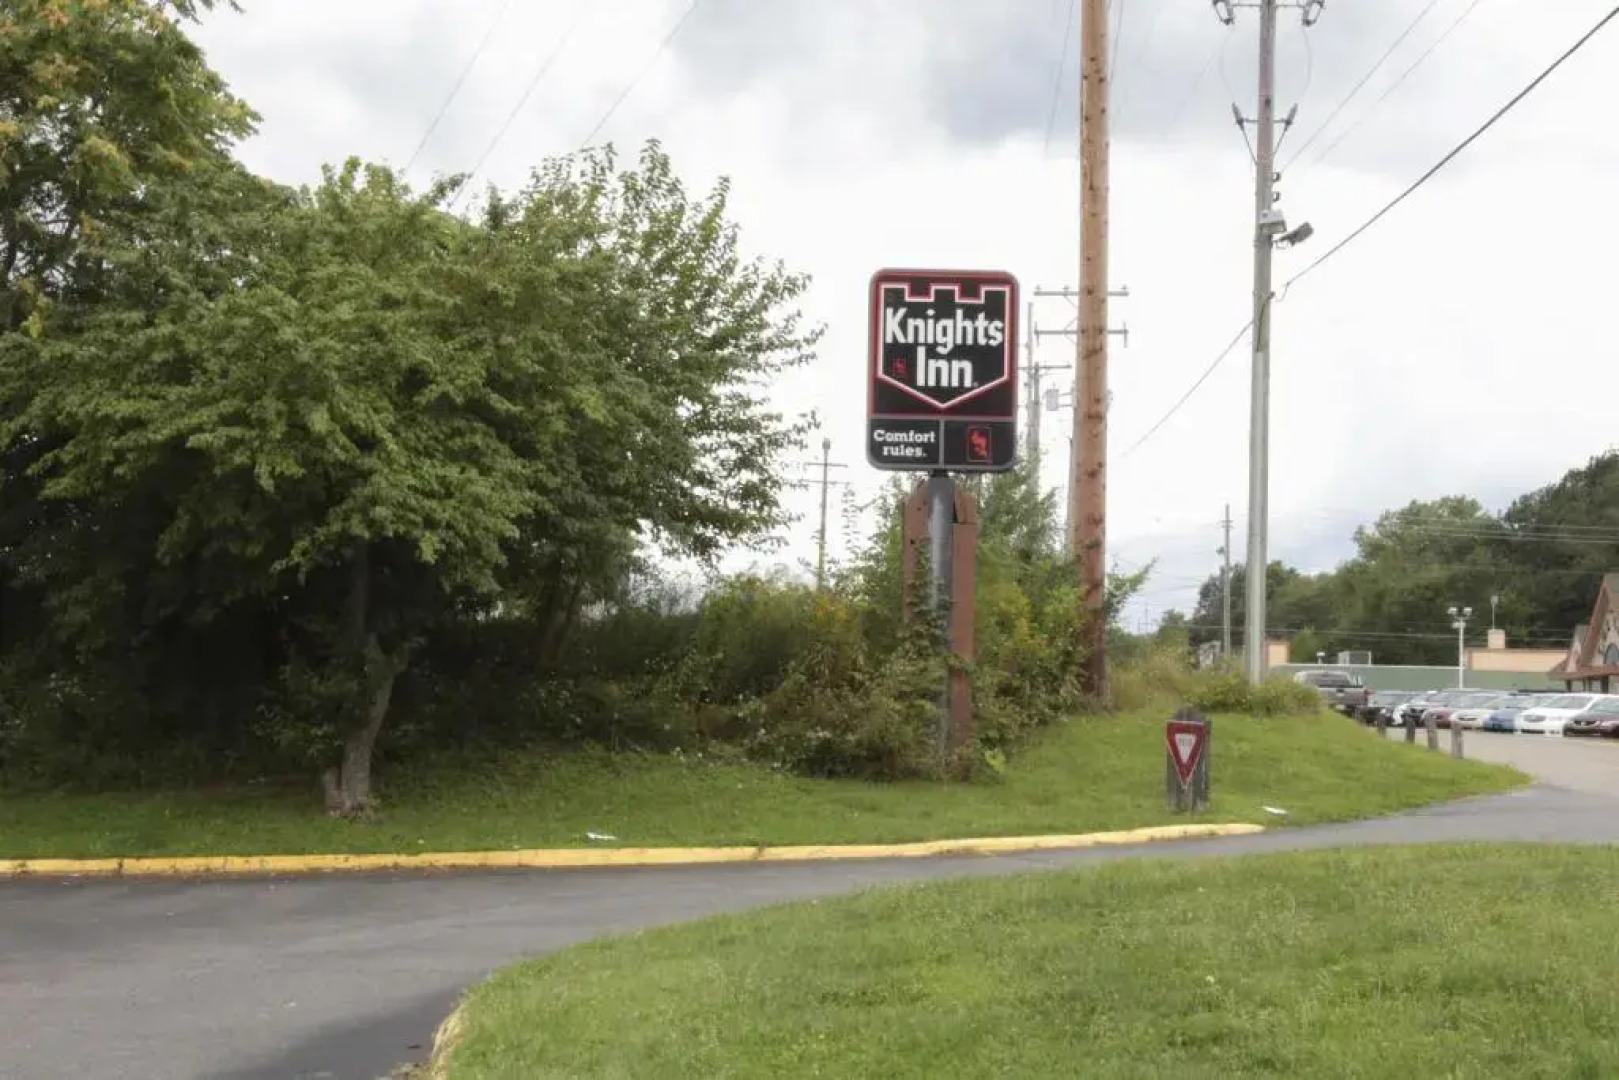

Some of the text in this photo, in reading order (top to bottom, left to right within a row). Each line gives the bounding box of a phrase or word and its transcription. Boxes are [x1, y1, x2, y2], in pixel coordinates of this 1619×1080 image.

[884, 307, 1004, 354] Knights
[916, 346, 973, 388] Inn
[873, 429, 936, 443] Comfort
[883, 443, 927, 457] rules.
